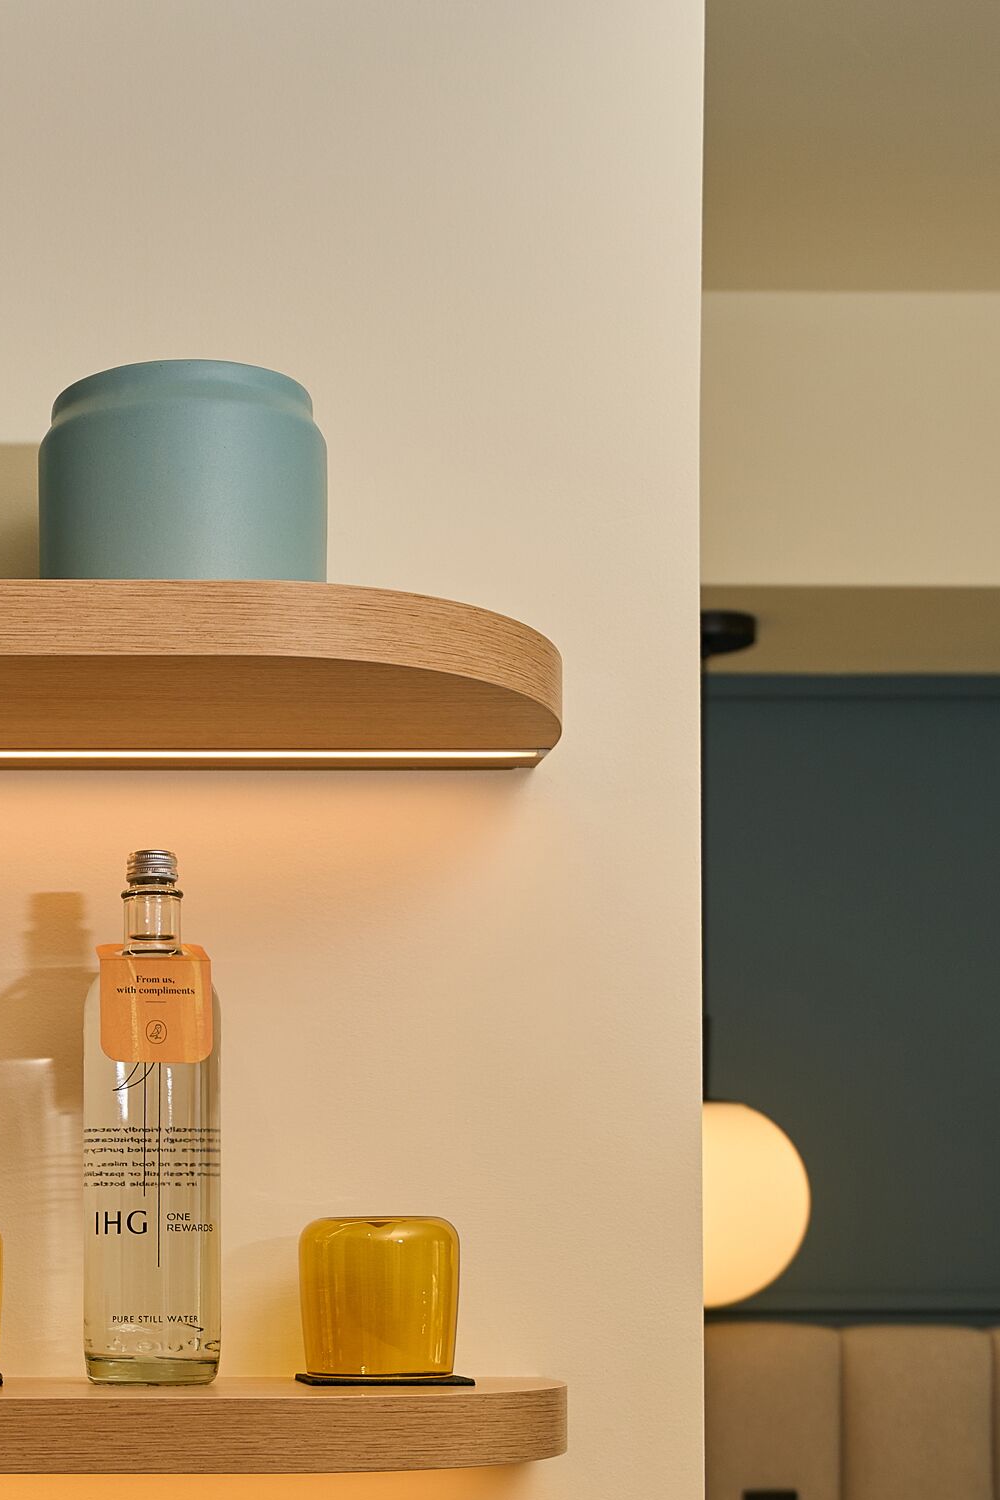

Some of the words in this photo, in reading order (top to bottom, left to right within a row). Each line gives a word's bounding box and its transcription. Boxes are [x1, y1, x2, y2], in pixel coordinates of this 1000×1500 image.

[136, 975, 160, 983] From
[116, 986, 137, 994] with
[138, 987, 195, 996] compliments
[95, 1210, 148, 1235] IHG
[167, 1213, 191, 1221] ONE
[167, 1224, 213, 1232] REWARDS
[112, 1315, 134, 1323] PURE
[138, 1315, 163, 1323] STILL
[167, 1315, 198, 1323] WATER
